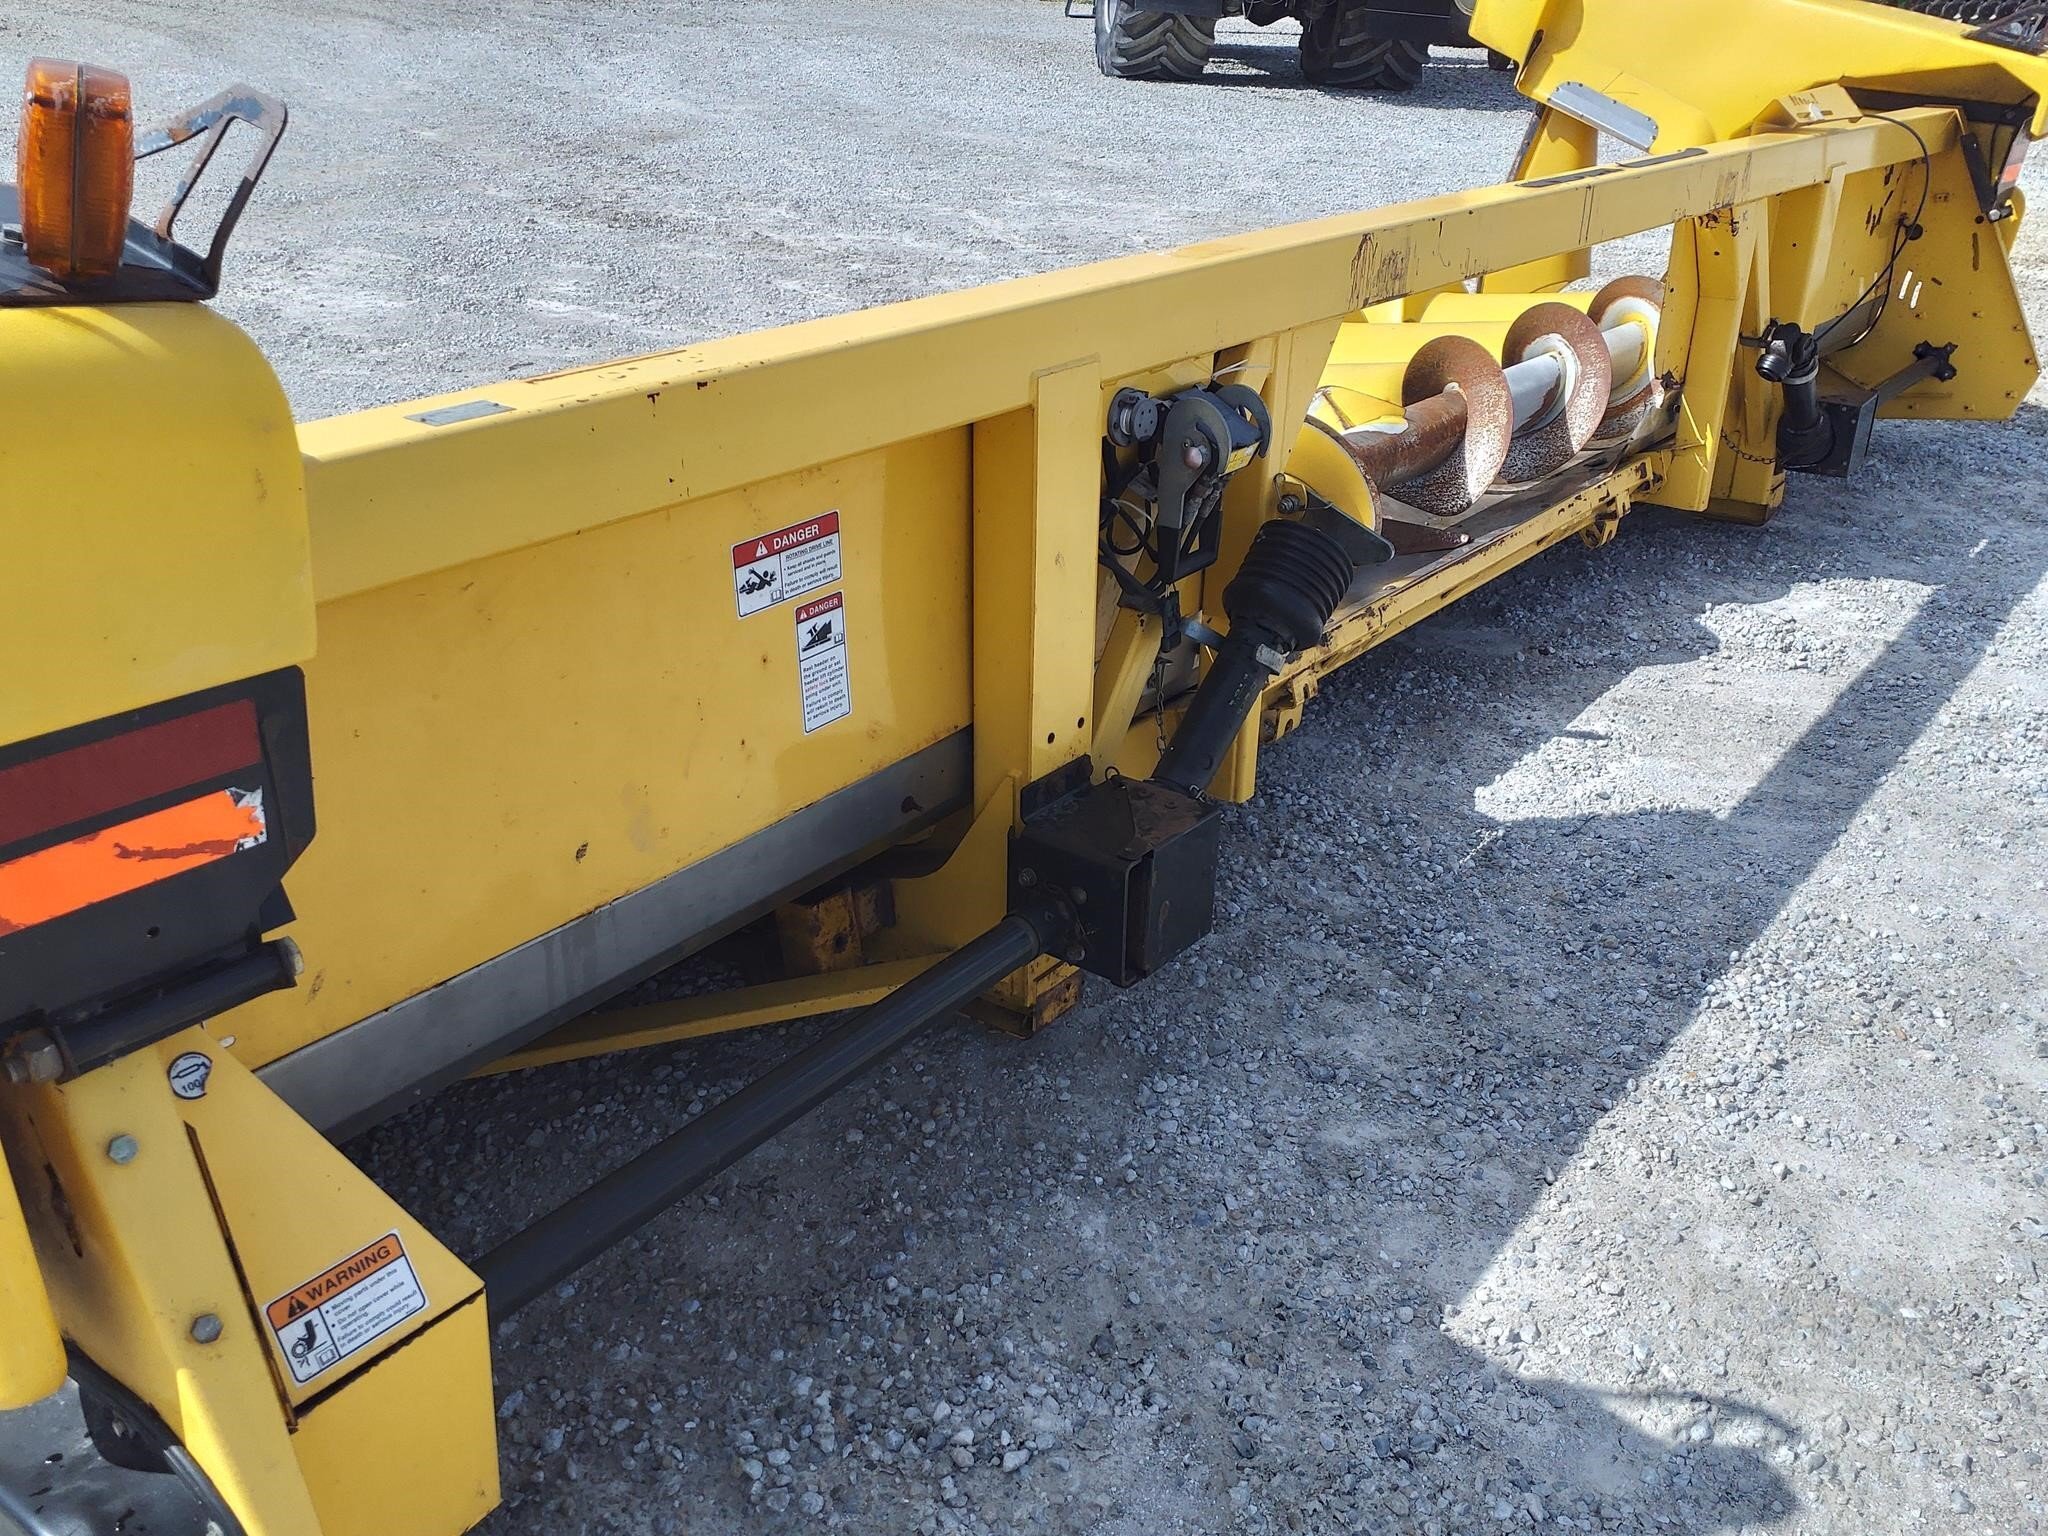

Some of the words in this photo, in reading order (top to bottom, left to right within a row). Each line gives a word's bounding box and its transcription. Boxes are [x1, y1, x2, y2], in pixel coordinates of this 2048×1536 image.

[774, 524, 820, 550] DANGER
[786, 548, 808, 560] ROTATING
[809, 543, 822, 551] DRIVE
[785, 578, 798, 588] Failure
[804, 571, 818, 580] comply
[807, 577, 821, 585] serious
[810, 598, 838, 615] DANGER
[812, 666, 827, 676] ground
[827, 665, 844, 676] cylinder
[829, 672, 842, 682] before
[806, 692, 818, 700] going
[819, 685, 831, 693] under
[806, 698, 821, 709] Failure
[828, 688, 843, 699] comply
[815, 702, 828, 711] result
[834, 694, 846, 702] death
[813, 709, 829, 719] serious
[306, 1246, 390, 1300] WARNING
[332, 1295, 353, 1311] Moving
[354, 1286, 368, 1298] parts
[369, 1275, 386, 1287] under
[386, 1268, 397, 1277] this
[358, 1301, 373, 1312] open
[373, 1291, 389, 1302] cover
[390, 1281, 404, 1292] while
[337, 1328, 357, 1342] Failure
[365, 1311, 385, 1326] comply
[386, 1300, 401, 1312] could
[402, 1290, 417, 1301] result
[347, 1332, 363, 1343] death
[372, 1314, 392, 1328] serious
